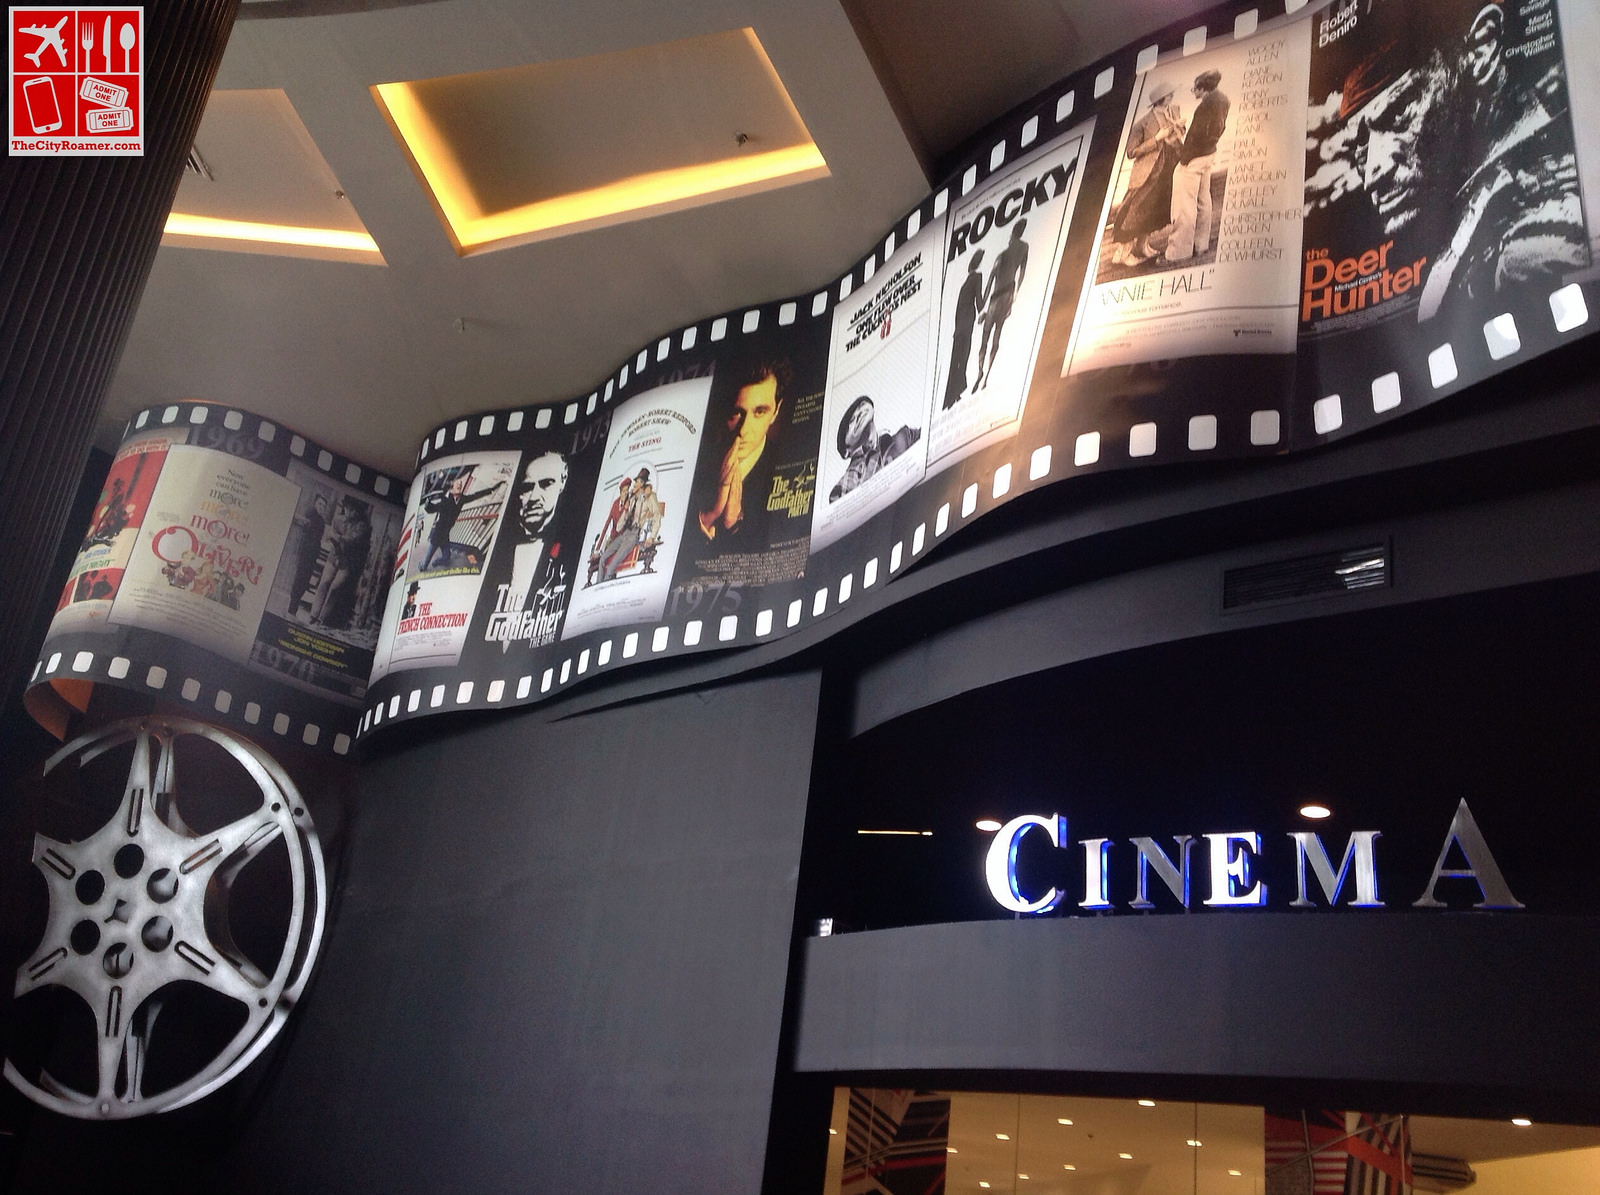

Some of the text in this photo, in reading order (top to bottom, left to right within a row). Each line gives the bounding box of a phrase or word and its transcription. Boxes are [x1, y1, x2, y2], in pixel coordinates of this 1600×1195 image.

[1320, 0, 1358, 35] Robert
[1525, 18, 1553, 36] Streep
[1528, 9, 1552, 26] Meryl
[1319, 15, 1357, 48] Deniro
[1505, 32, 1554, 58] Christopher
[1523, 40, 1555, 58] Walken
[947, 156, 1078, 263] ROCKY
[1224, 208, 1302, 225] CHRISTOPHER
[1224, 223, 1271, 237] WALKEN
[1220, 237, 1274, 251] COLLEEN
[1219, 248, 1283, 263] DEWHURST
[1305, 248, 1329, 260] the
[1304, 240, 1394, 291] Deer
[850, 252, 922, 325] JACK NICHOLSON
[1302, 256, 1427, 322] Hunter
[846, 334, 861, 352] THE
[641, 437, 662, 448] STING
[772, 475, 790, 494] The
[209, 489, 250, 509] more
[767, 487, 814, 512] Godfather
[190, 513, 250, 546] more!
[417, 602, 433, 617] THE
[668, 583, 742, 617] 1975
[419, 612, 469, 631] CONNECTION
[484, 607, 564, 650] Godfather
[985, 796, 1526, 914] CINEMA
